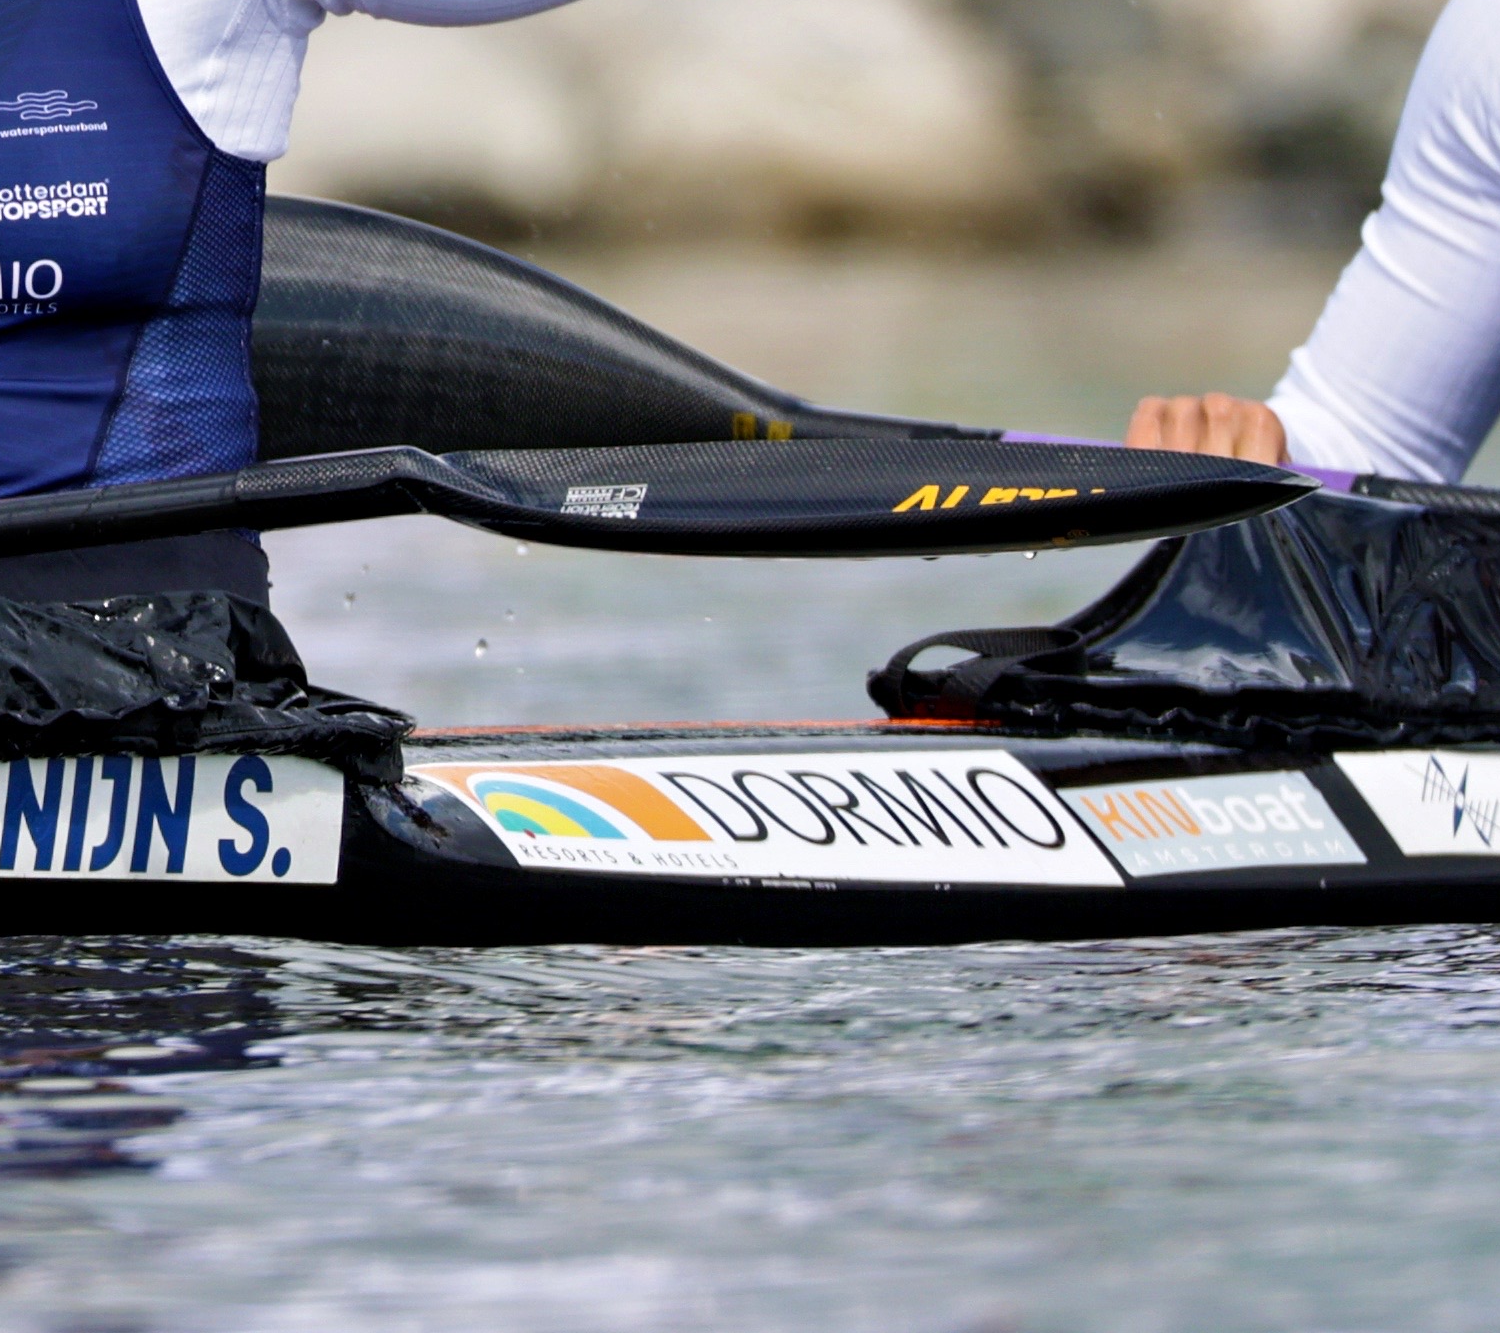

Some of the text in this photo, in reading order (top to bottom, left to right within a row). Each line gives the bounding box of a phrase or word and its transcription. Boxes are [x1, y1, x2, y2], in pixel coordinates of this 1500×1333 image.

[0, 121, 108, 139] watersportverbond
[217, 755, 293, 878] S.
[657, 768, 1067, 849] DORMIO
[1078, 783, 1326, 844] KINboat
[518, 843, 740, 869] RESORTS & HOTELS
[1132, 837, 1348, 870] AMSTERDAM
